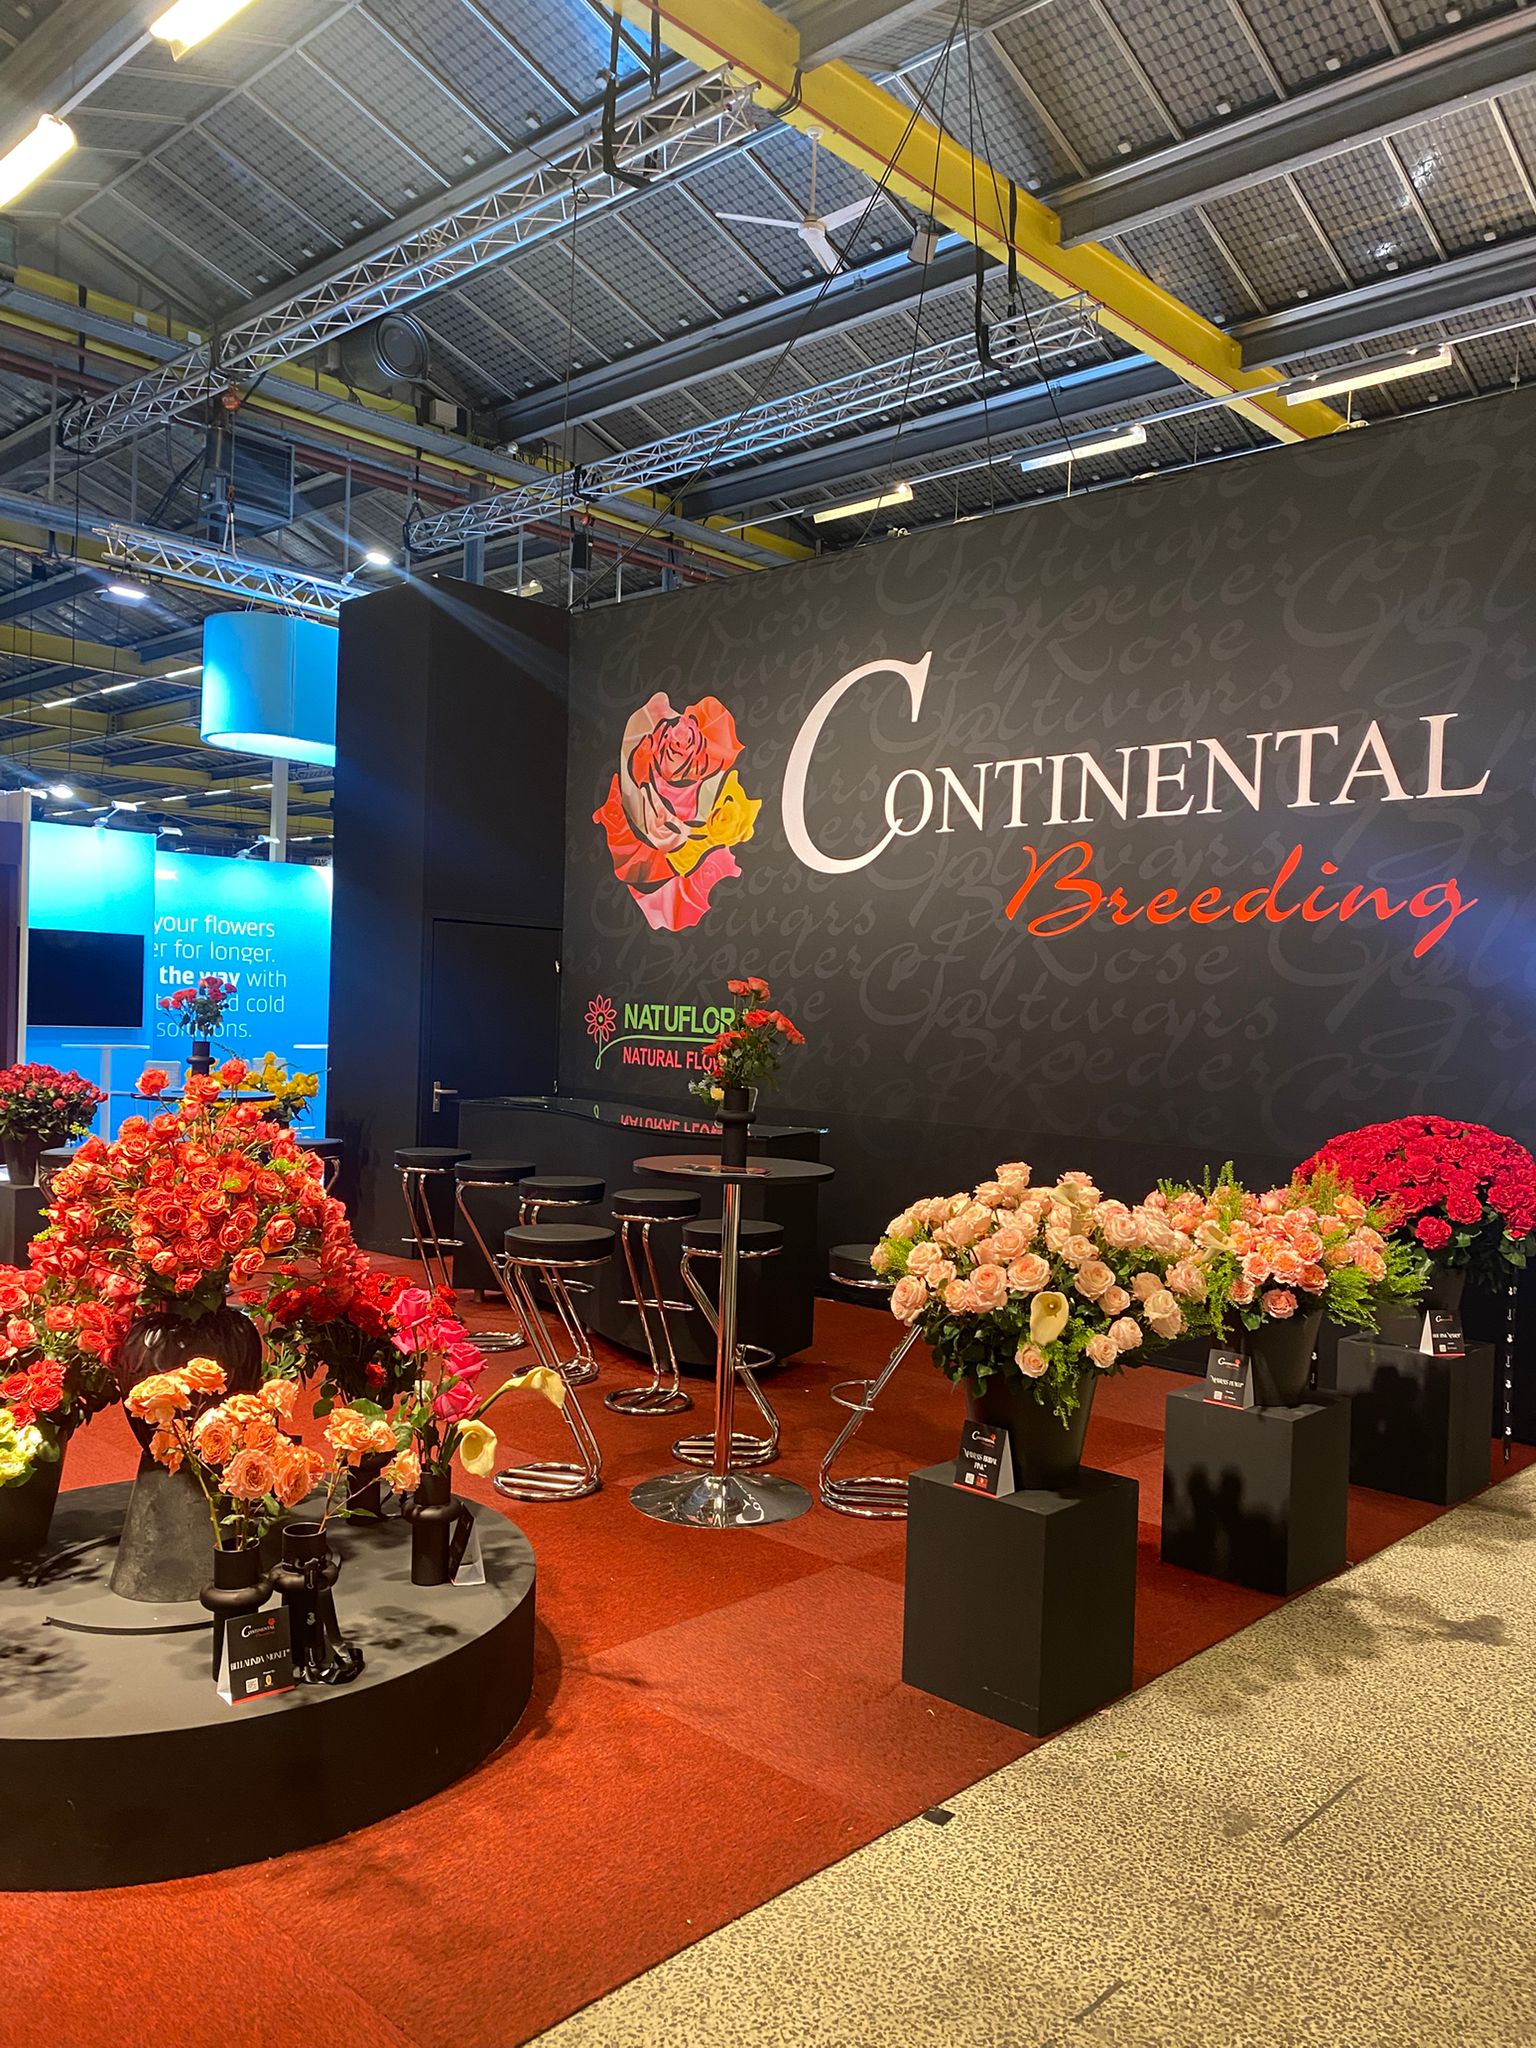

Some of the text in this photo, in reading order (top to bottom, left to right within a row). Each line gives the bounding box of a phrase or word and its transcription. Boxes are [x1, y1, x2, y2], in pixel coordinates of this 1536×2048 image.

[1006, 840, 1479, 959] Breeding
[154, 914, 275, 937] your flowers
[174, 939, 203, 959] for
[210, 941, 276, 965] longer.
[159, 965, 195, 985] the
[246, 969, 287, 988] with
[246, 994, 285, 1013] cold
[624, 1003, 749, 1035] NATUFLOR
[623, 1046, 682, 1069] NATURAL
